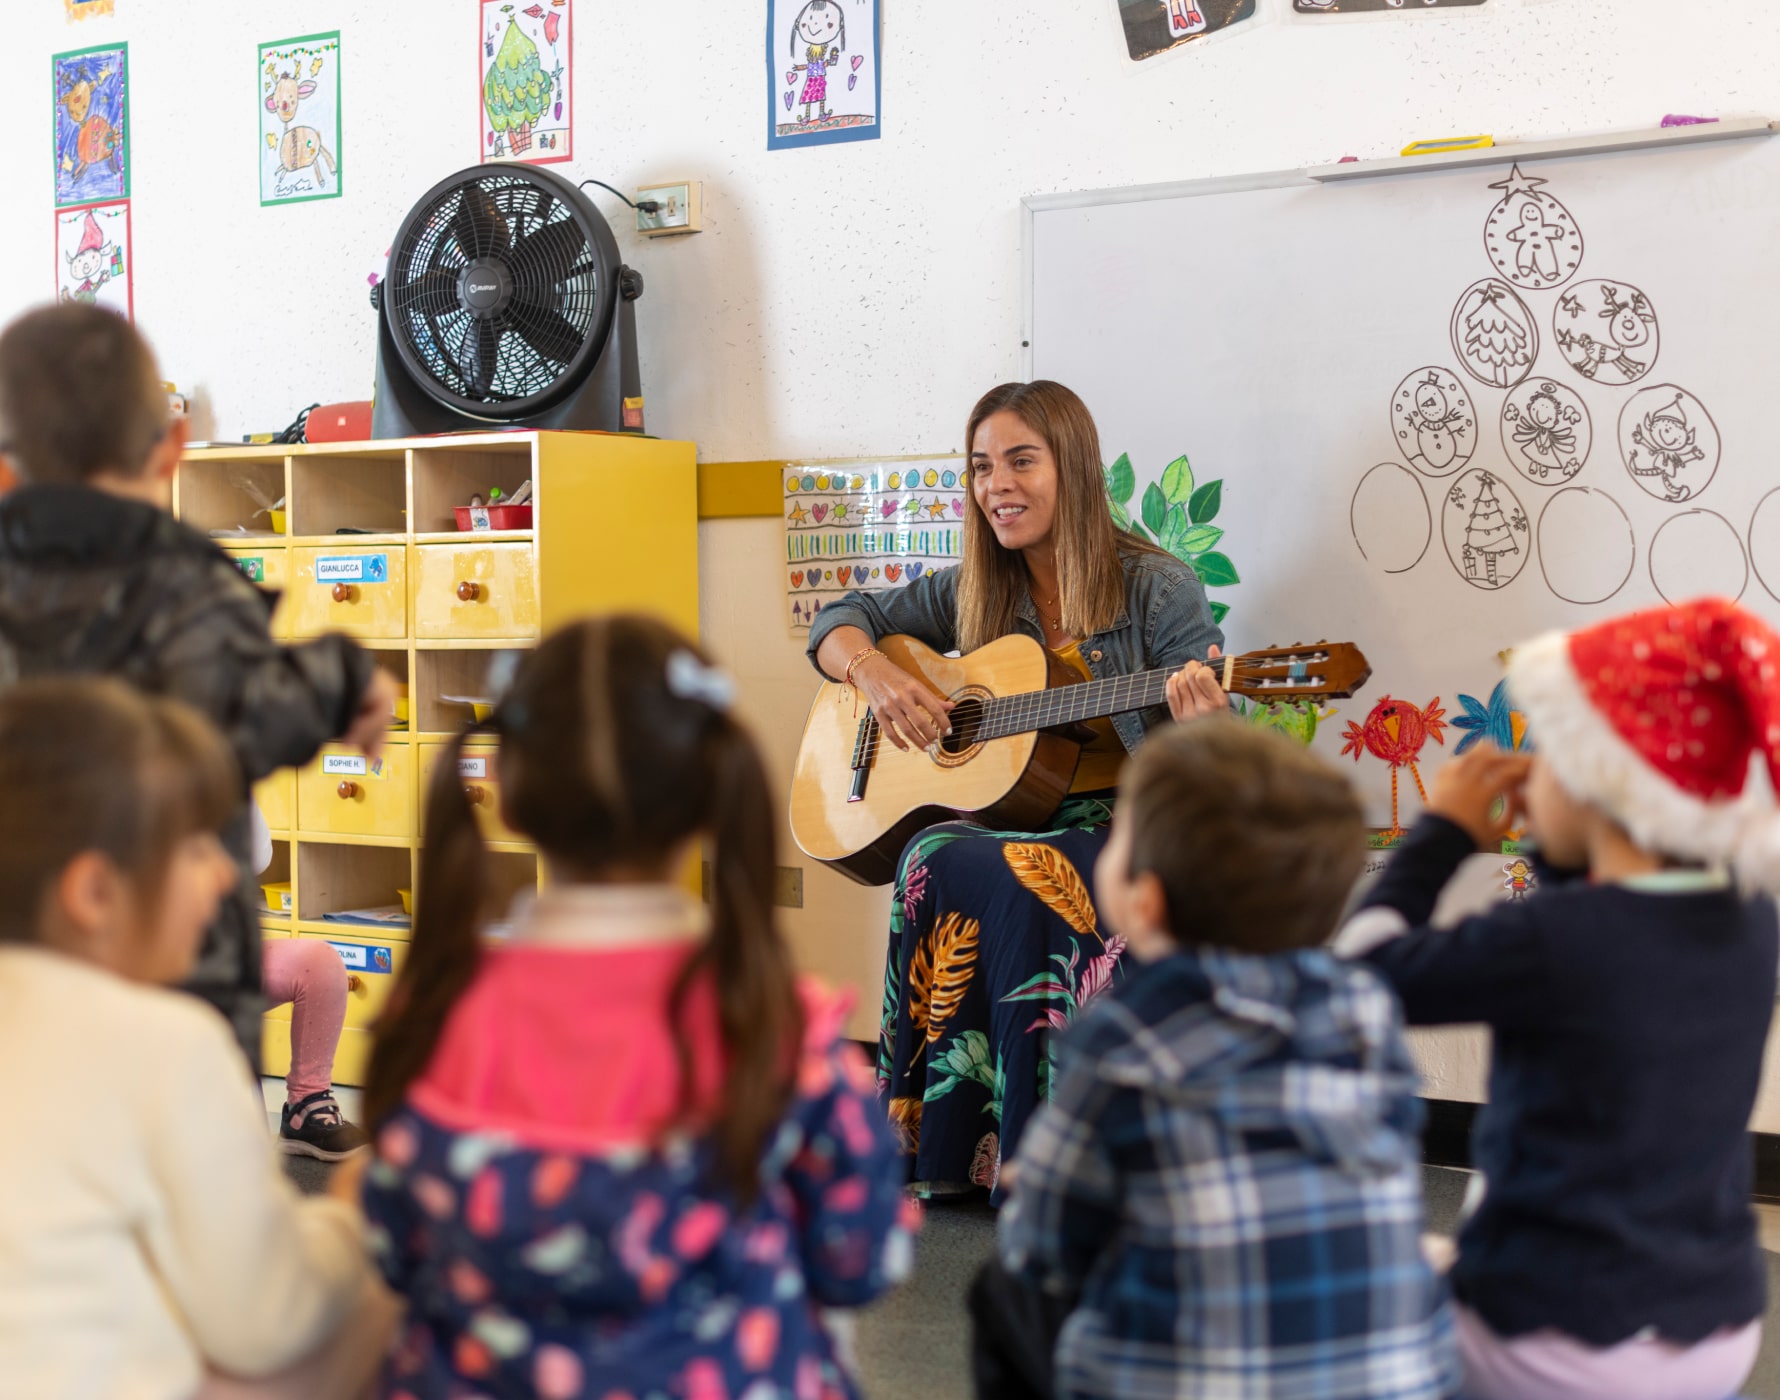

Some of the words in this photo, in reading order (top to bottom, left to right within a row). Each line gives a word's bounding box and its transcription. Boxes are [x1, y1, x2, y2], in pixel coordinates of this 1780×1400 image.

[320, 564, 359, 573] GIANLUCCA
[329, 759, 353, 767] SOPHIE
[457, 762, 478, 770] CIANO
[338, 950, 357, 959] OLINA
